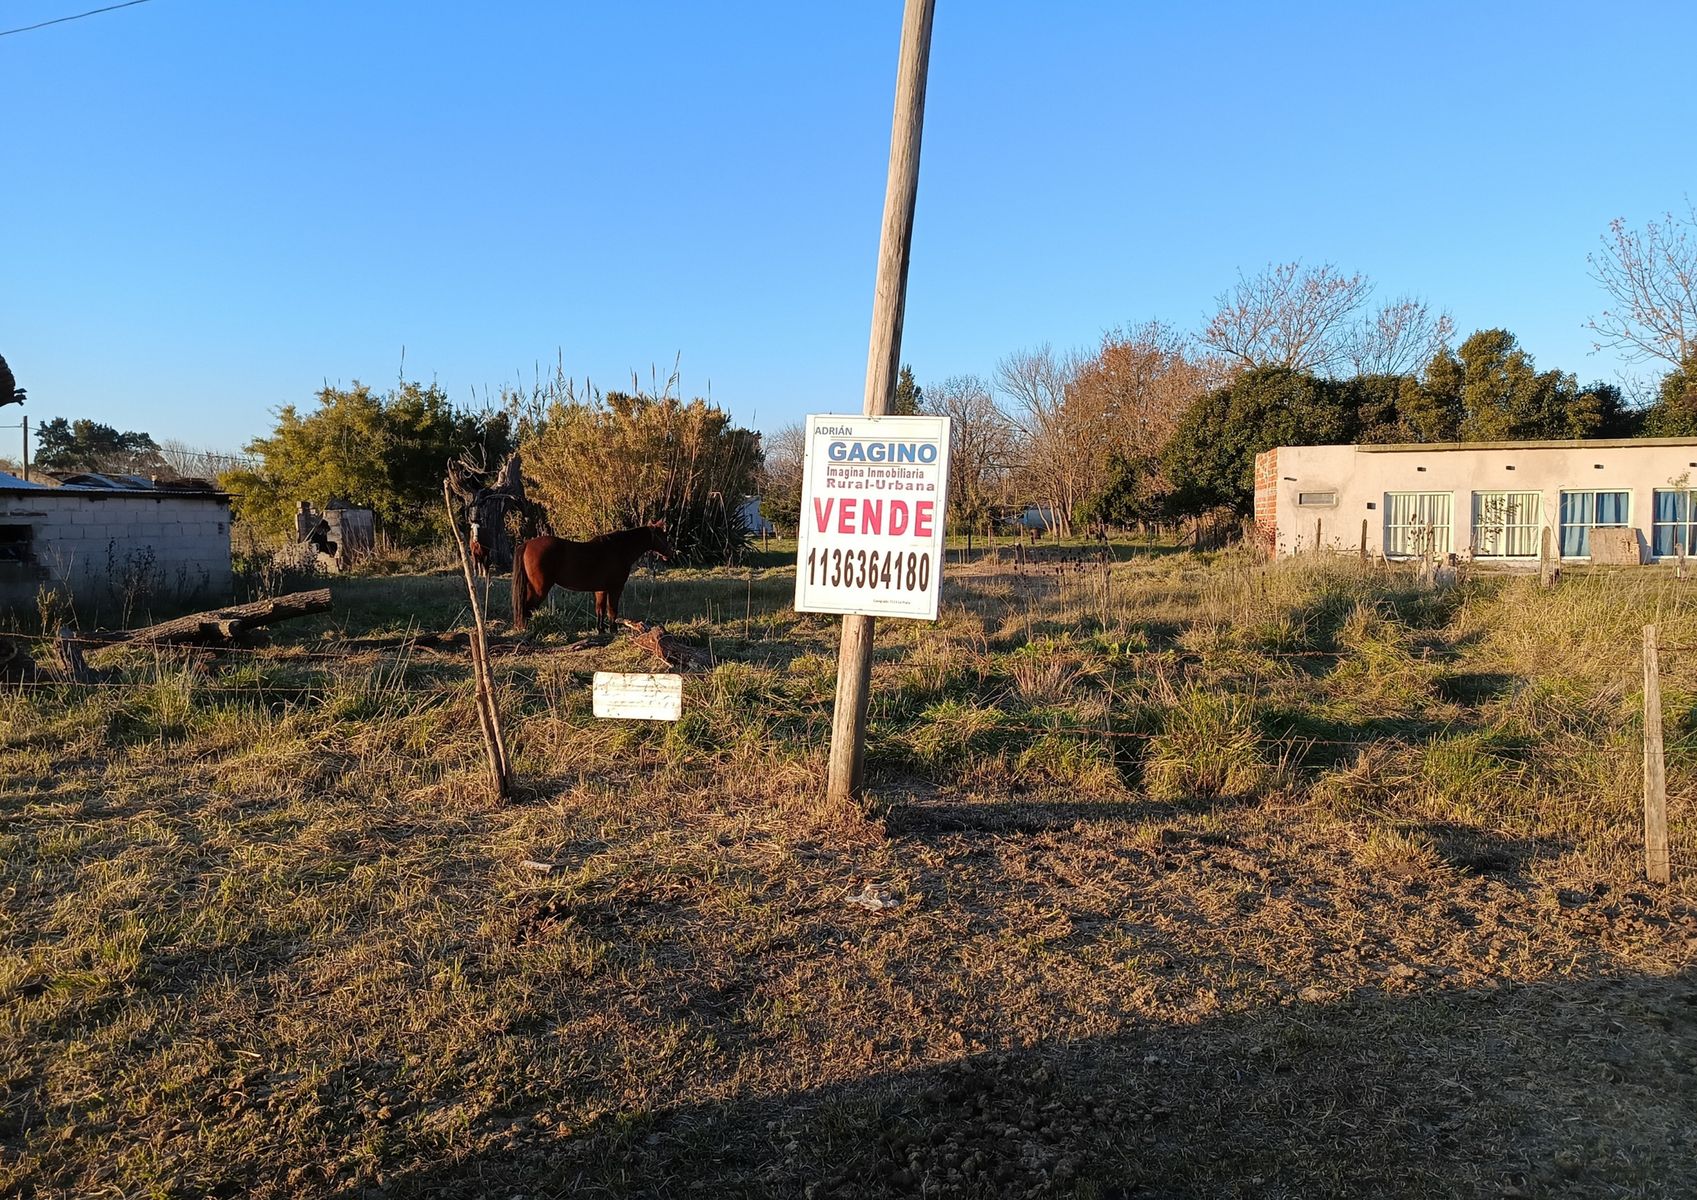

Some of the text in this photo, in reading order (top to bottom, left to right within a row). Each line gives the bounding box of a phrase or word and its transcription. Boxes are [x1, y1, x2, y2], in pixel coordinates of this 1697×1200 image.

[815, 424, 853, 436] ADRIÁN
[828, 441, 937, 463] GAGINO
[826, 466, 924, 479] Imagina Inmobiliaria
[826, 478, 935, 492] Rural-Urbana
[814, 497, 934, 537] VENDE
[808, 547, 929, 592] 1136364180
